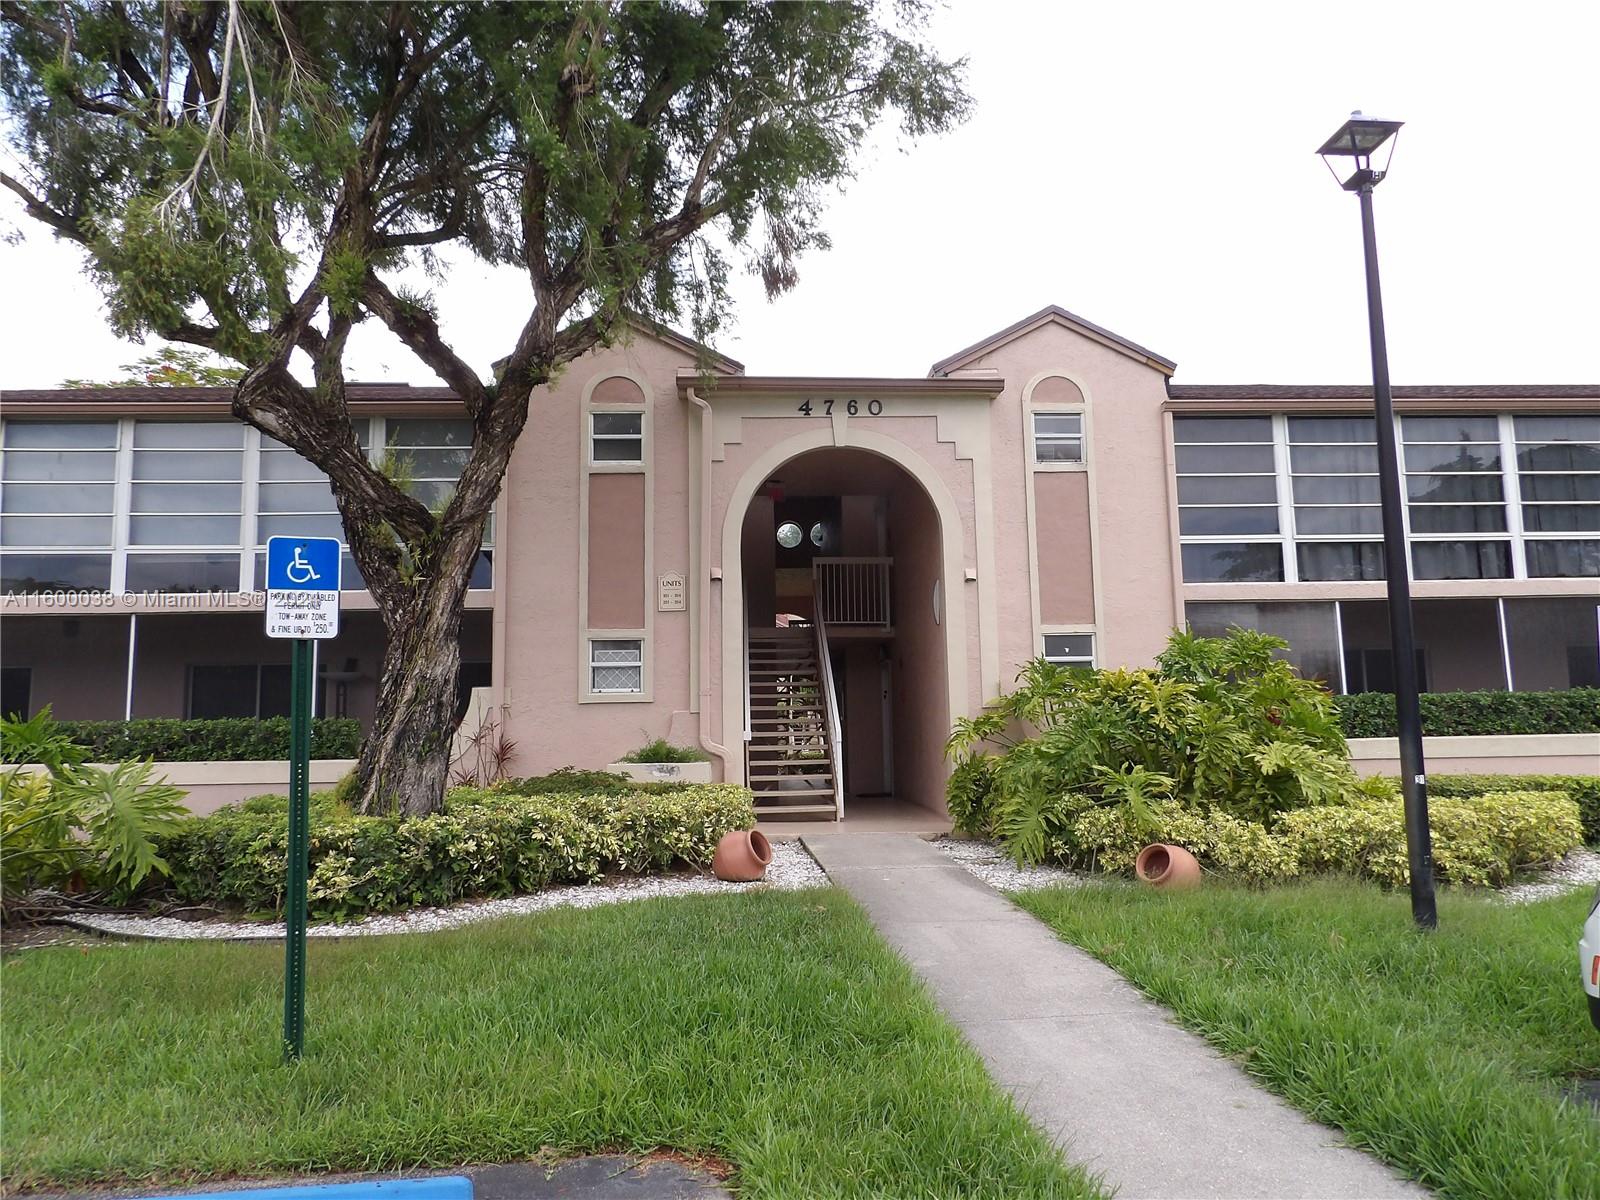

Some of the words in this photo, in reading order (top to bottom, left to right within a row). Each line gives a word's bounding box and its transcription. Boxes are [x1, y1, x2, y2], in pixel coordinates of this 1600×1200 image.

[798, 399, 882, 416] 4760
[278, 612, 309, 620] TOW-AWAY
[311, 612, 327, 620] ZONE
[278, 625, 291, 633] FINE
